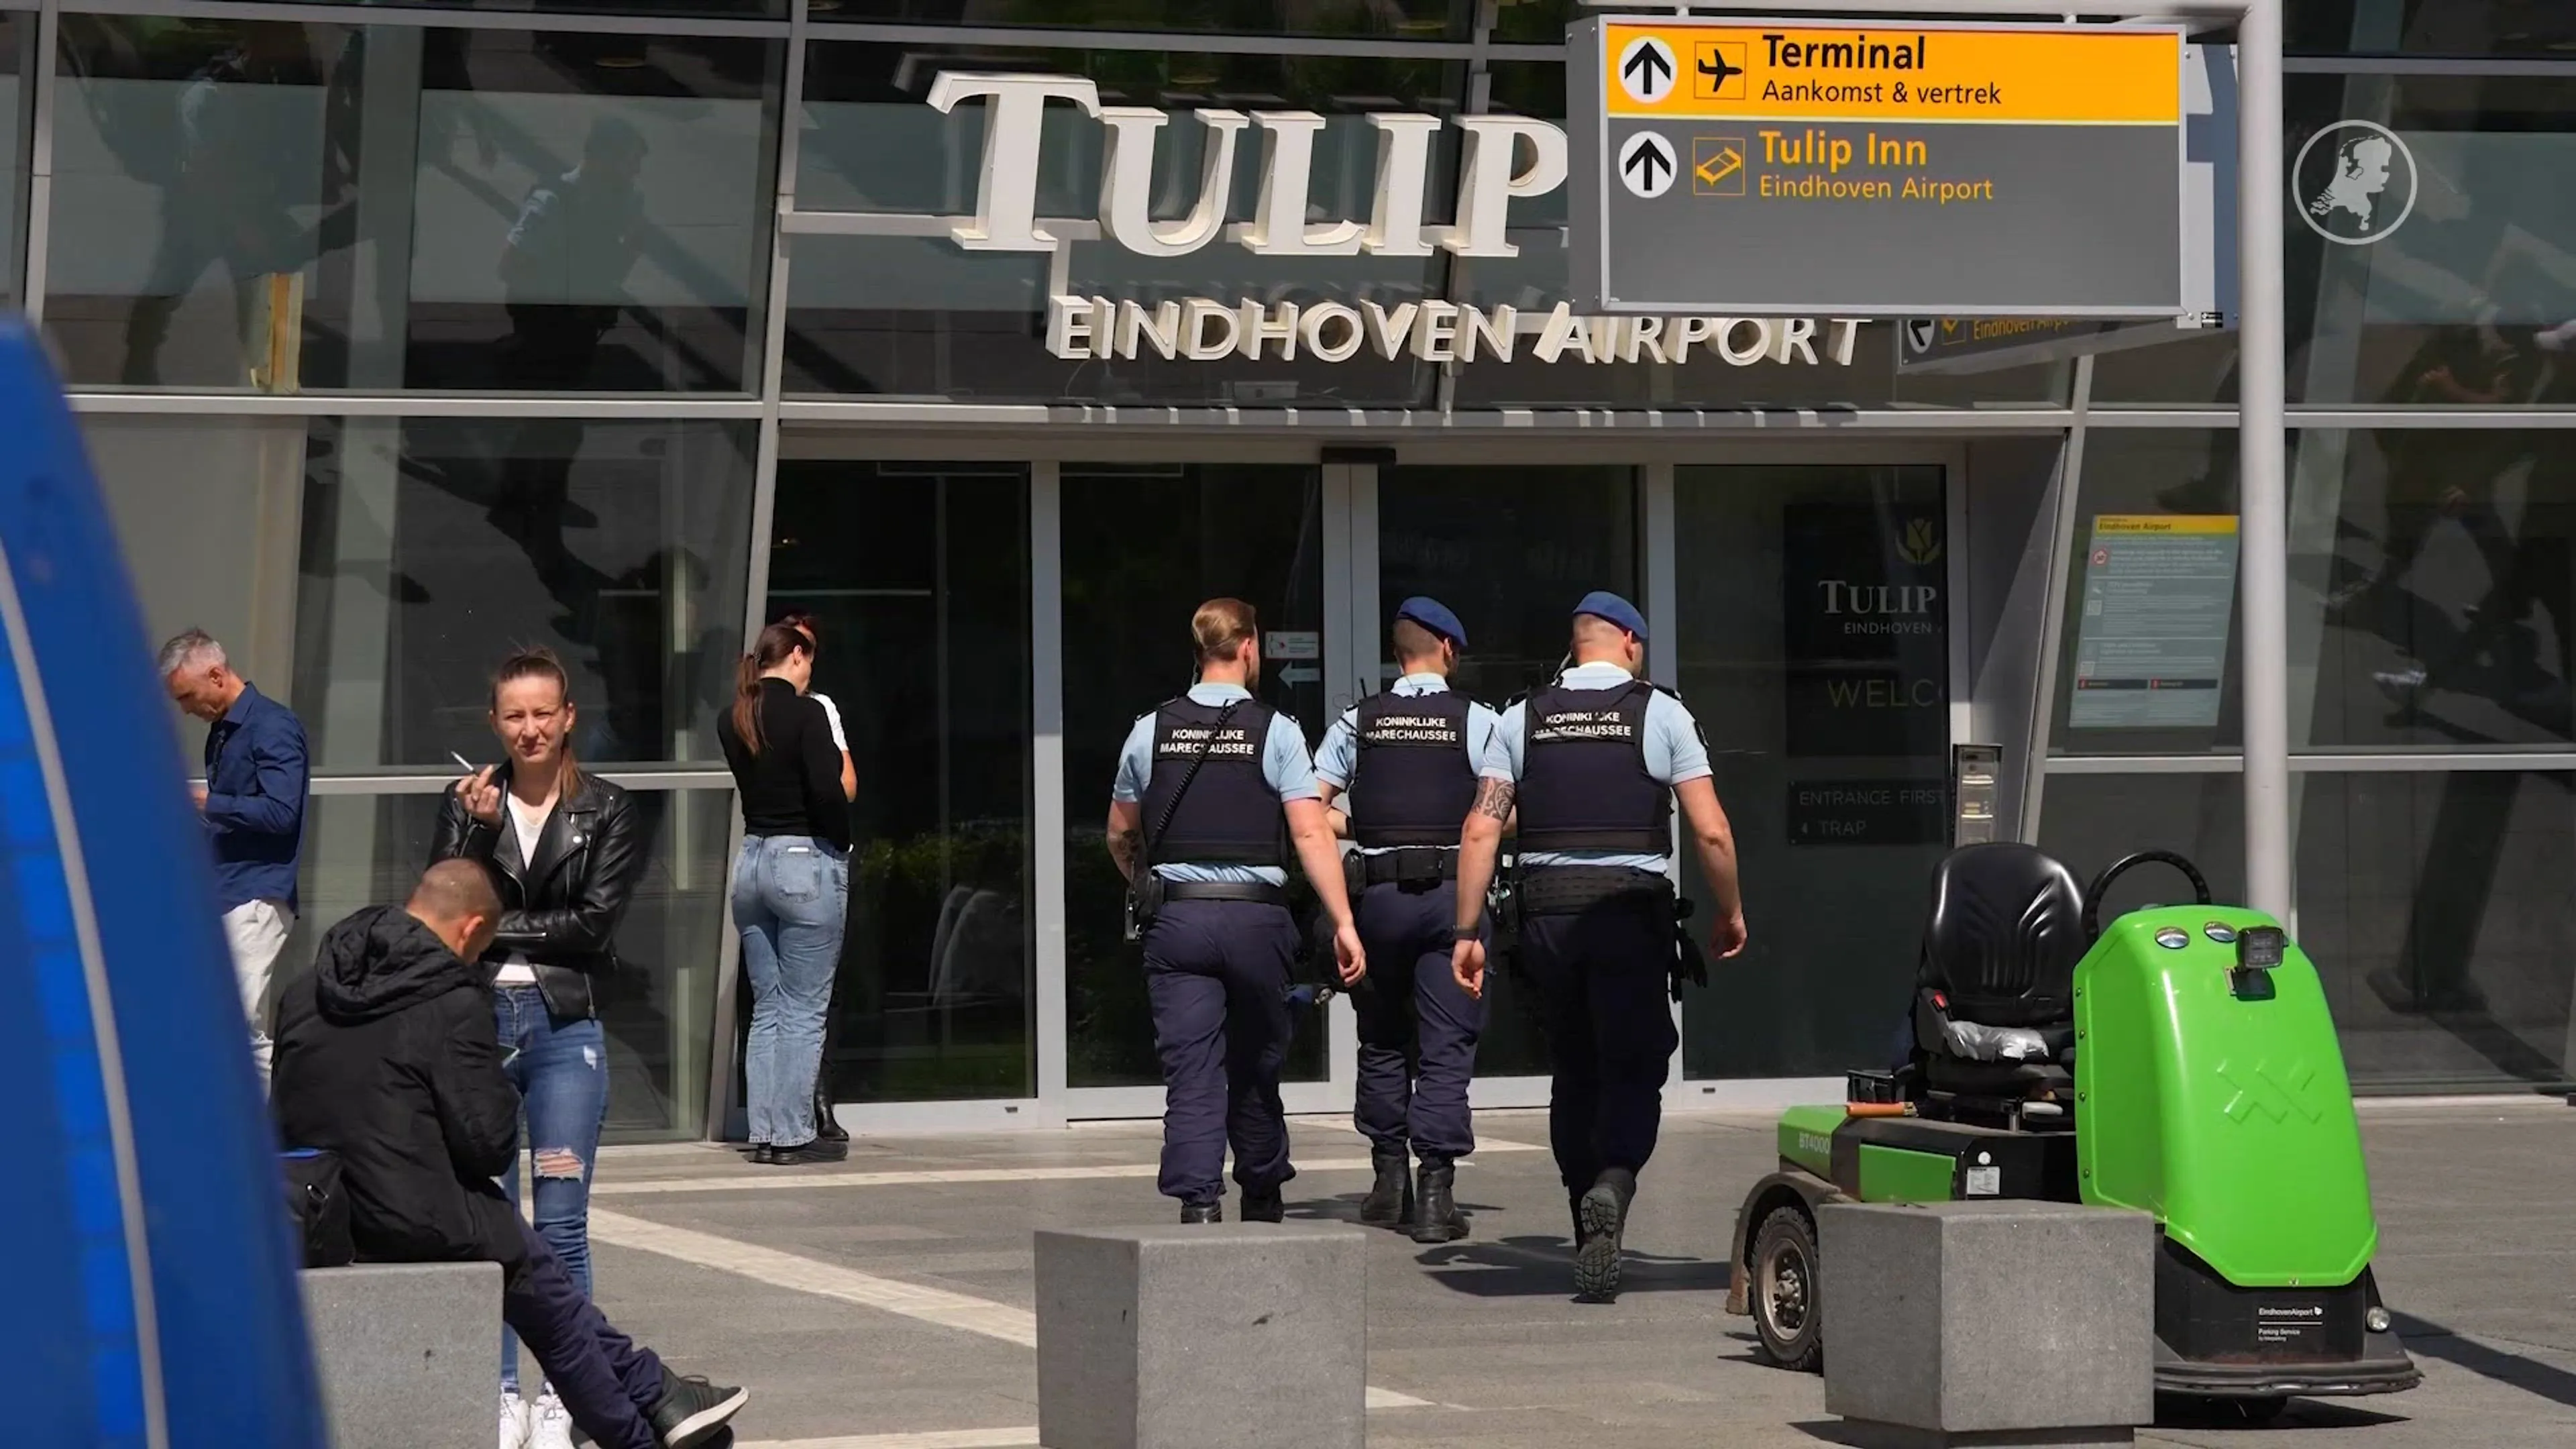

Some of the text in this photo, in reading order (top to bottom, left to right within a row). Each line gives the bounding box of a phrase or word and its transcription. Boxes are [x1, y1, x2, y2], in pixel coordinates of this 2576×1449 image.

[1762, 34, 1926, 70] Terminal
[1762, 79, 2002, 105] Aankomst & vertrek
[926, 70, 1568, 258] TULIP
[1758, 129, 1927, 173] Tulip Inn
[1760, 174, 1994, 205] Eindhoven Airport
[1046, 295, 1873, 366] EINDHOVEN AIRPORT
[1818, 580, 1937, 614] TULIP
[1844, 623, 1932, 634] EINDHOVEN
[1827, 679, 1942, 708] WELC
[1376, 716, 1446, 728] KONINKLIJKE
[1546, 712, 1621, 724] KONINKLKE
[1160, 743, 1254, 755] MARECAUSSEE
[1799, 790, 1891, 806] ENTRANCE
[1817, 820, 1868, 836] TRAP
